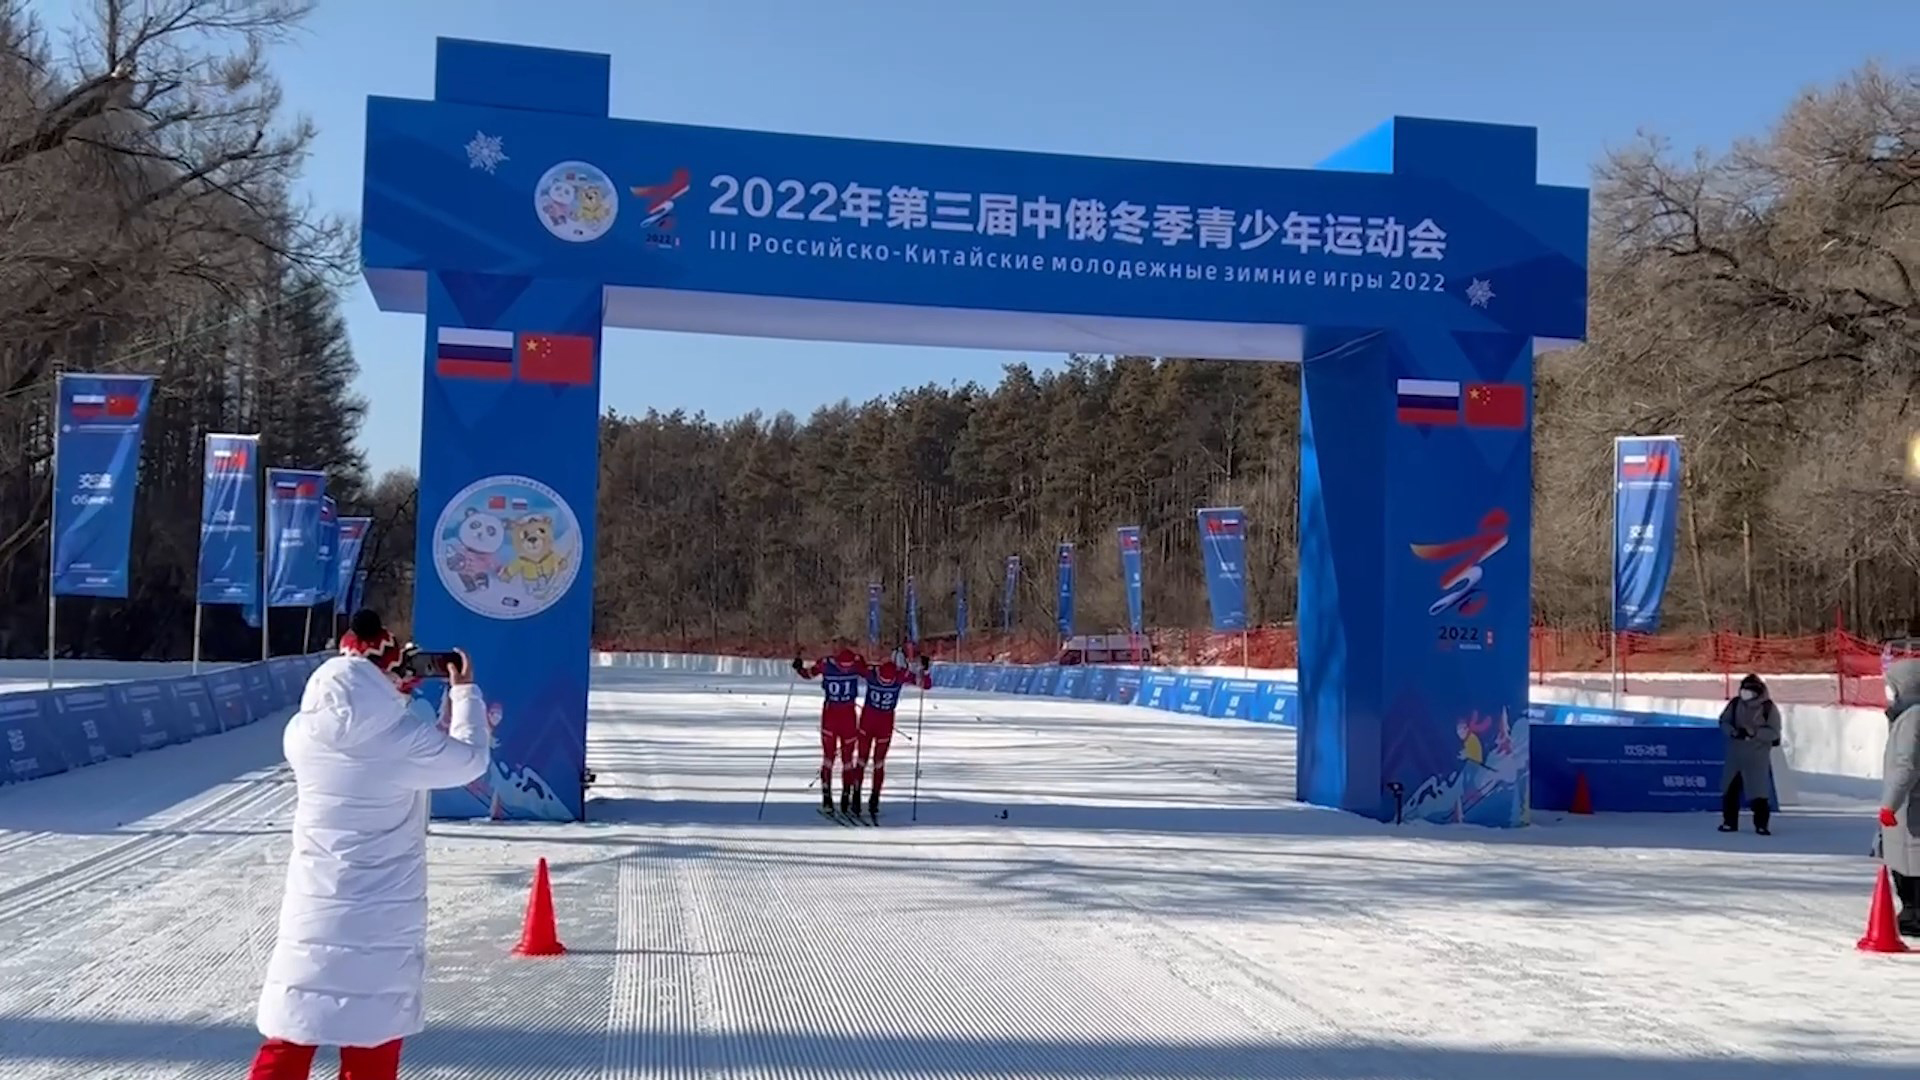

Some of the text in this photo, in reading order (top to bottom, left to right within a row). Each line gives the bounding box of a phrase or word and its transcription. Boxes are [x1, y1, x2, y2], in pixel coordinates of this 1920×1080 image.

[710, 174, 1447, 261] 2022年第三届中俄冬季青少年运动会
[748, 233, 1044, 272] Российско-Китайские
[1052, 256, 1217, 281] молодежные
[1224, 265, 1316, 286] зимние
[1323, 271, 1383, 292] игры
[1389, 270, 1446, 292] 2022
[1438, 626, 1479, 640] 2022
[828, 681, 851, 695] 01
[870, 690, 894, 705] 02
